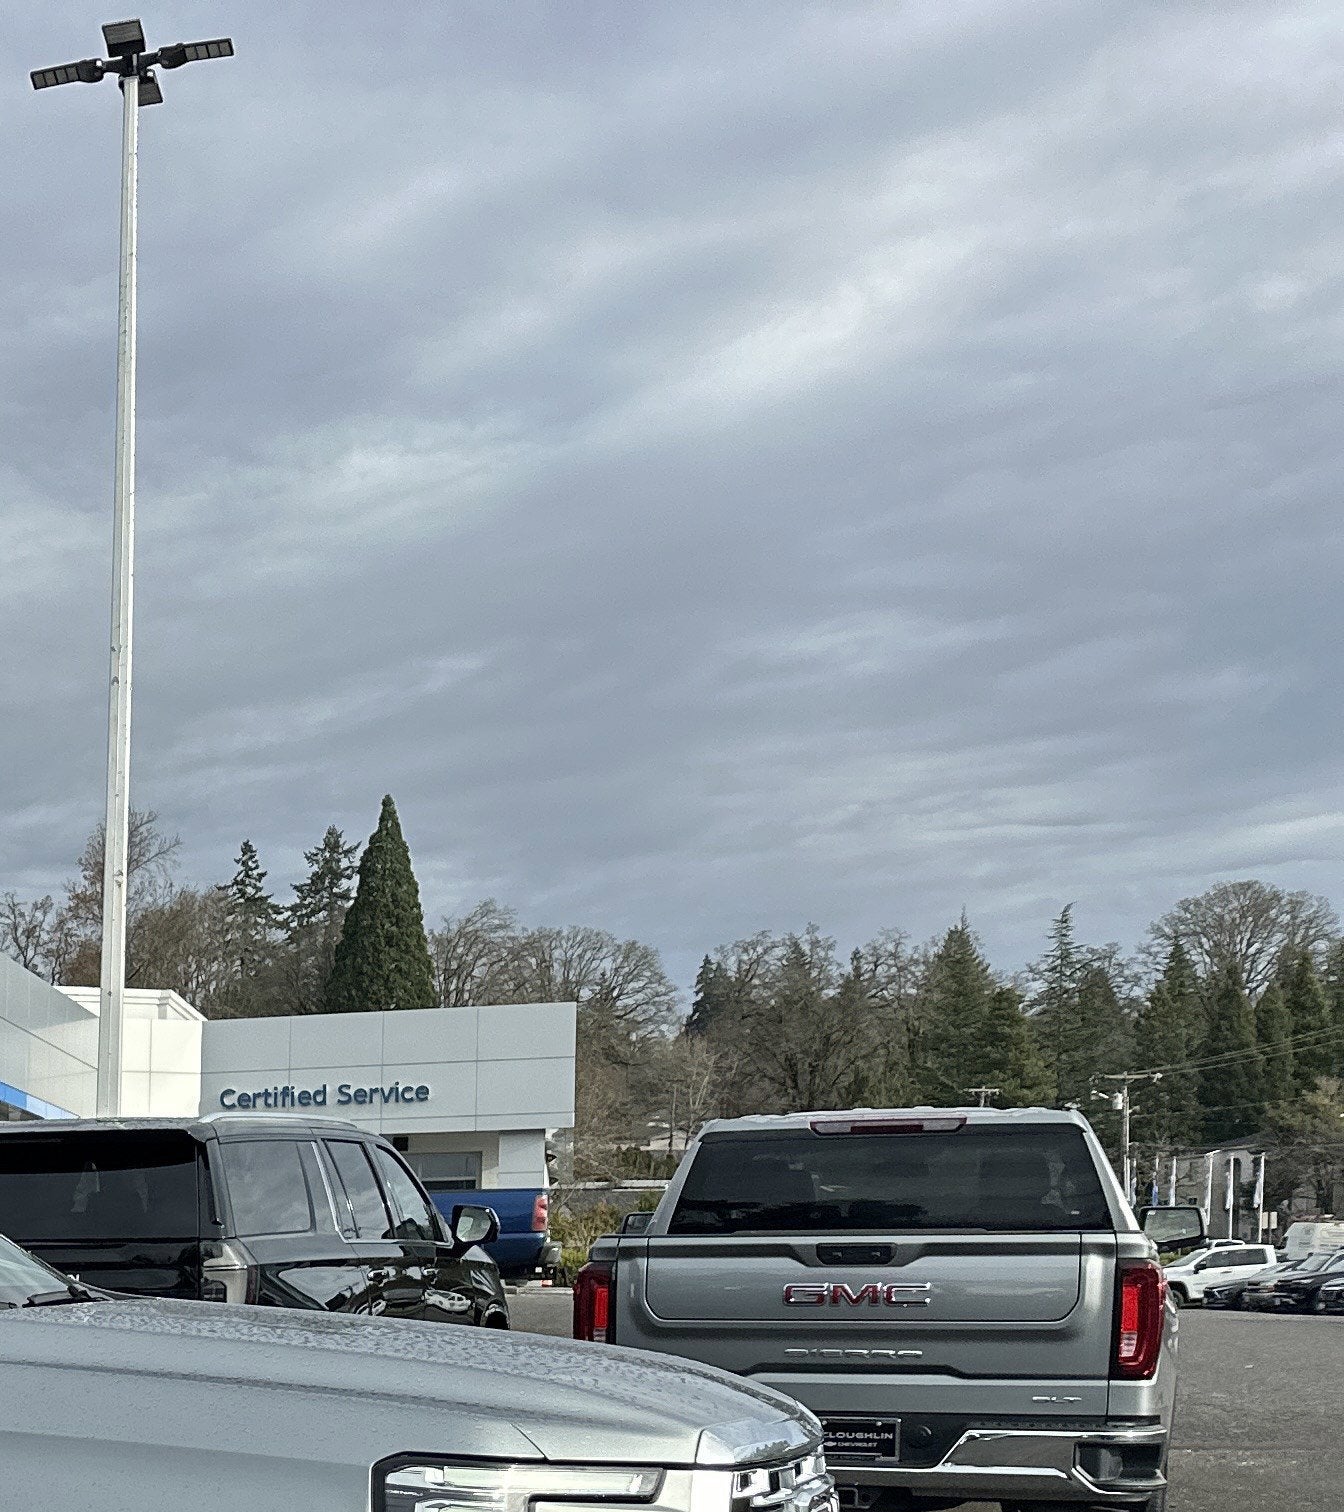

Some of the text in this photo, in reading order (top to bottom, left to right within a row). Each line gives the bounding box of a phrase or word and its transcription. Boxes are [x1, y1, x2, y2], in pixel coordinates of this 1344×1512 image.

[219, 1081, 430, 1109] Certified Service
[783, 1282, 932, 1307] GMC
[784, 1348, 923, 1359] SIERRA
[824, 1431, 894, 1439] CLOUGHLIN
